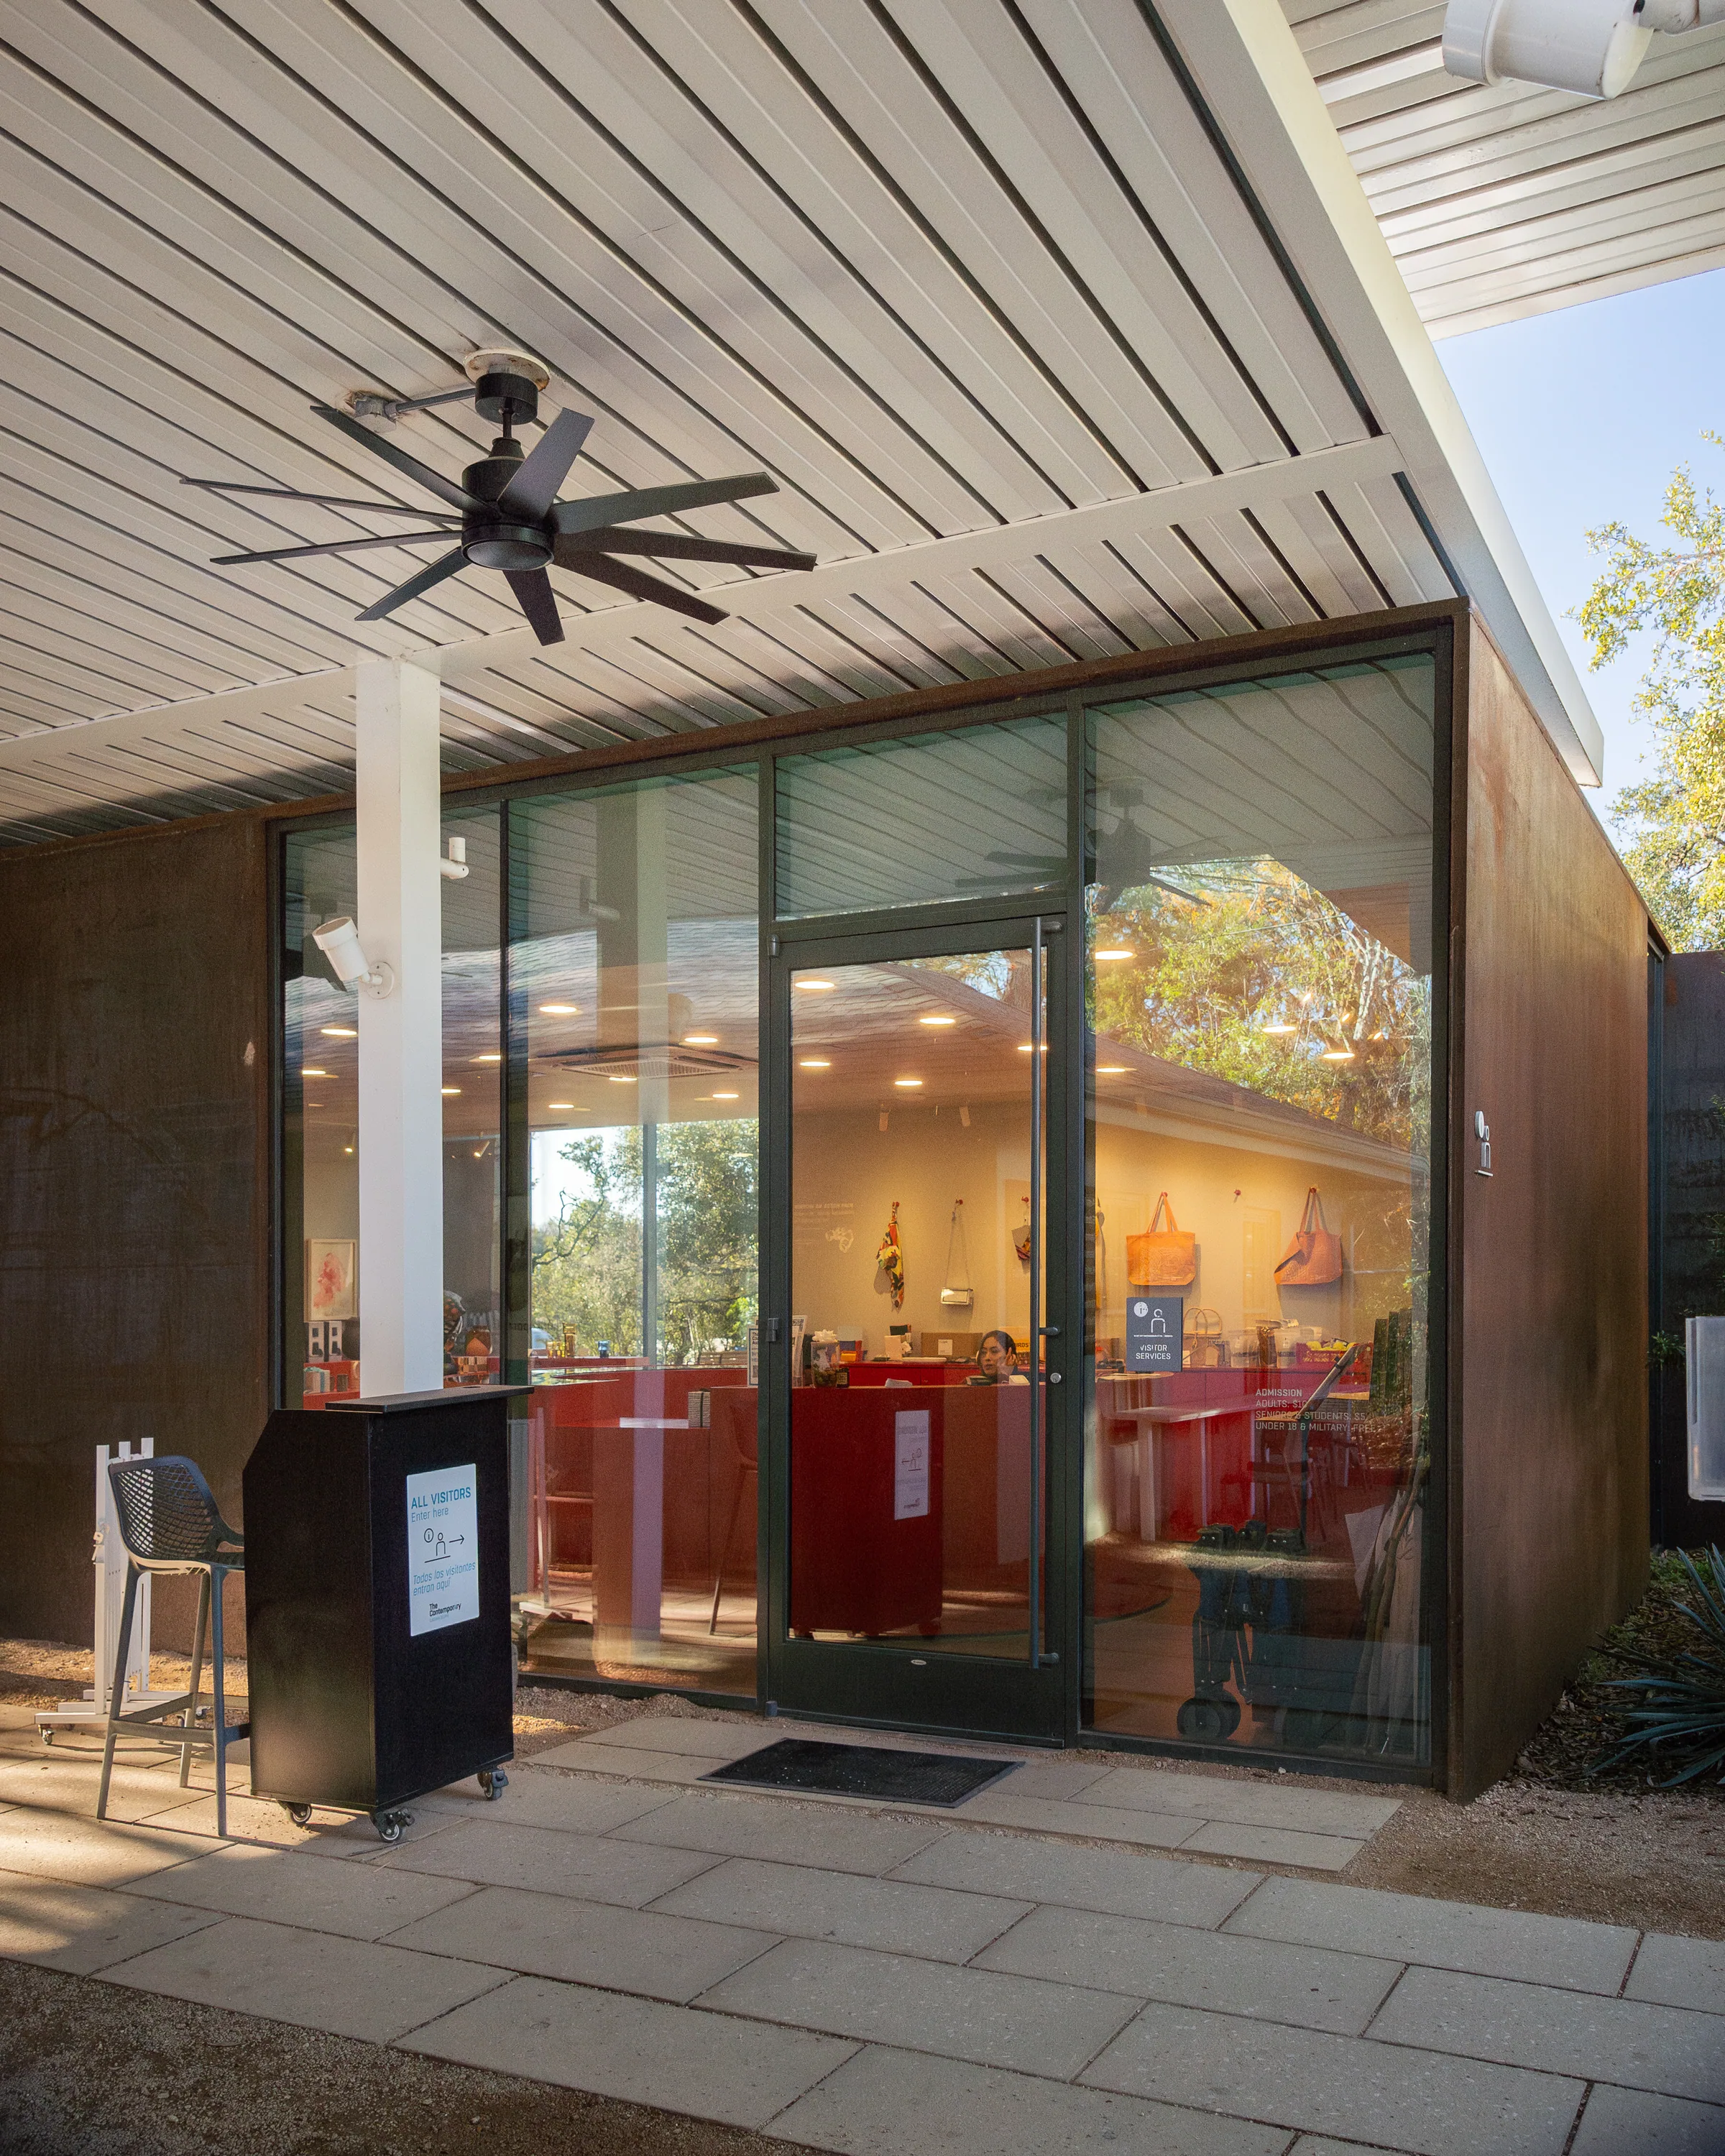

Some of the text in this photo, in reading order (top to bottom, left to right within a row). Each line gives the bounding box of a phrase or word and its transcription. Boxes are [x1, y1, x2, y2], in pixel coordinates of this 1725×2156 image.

[1255, 1388, 1302, 1397] ADMISSION
[411, 1486, 472, 1509] ALL VISITORS
[411, 1507, 449, 1522] Enter here
[413, 1562, 476, 1585] Todos los visitantes
[413, 1577, 451, 1596] entran aquí
